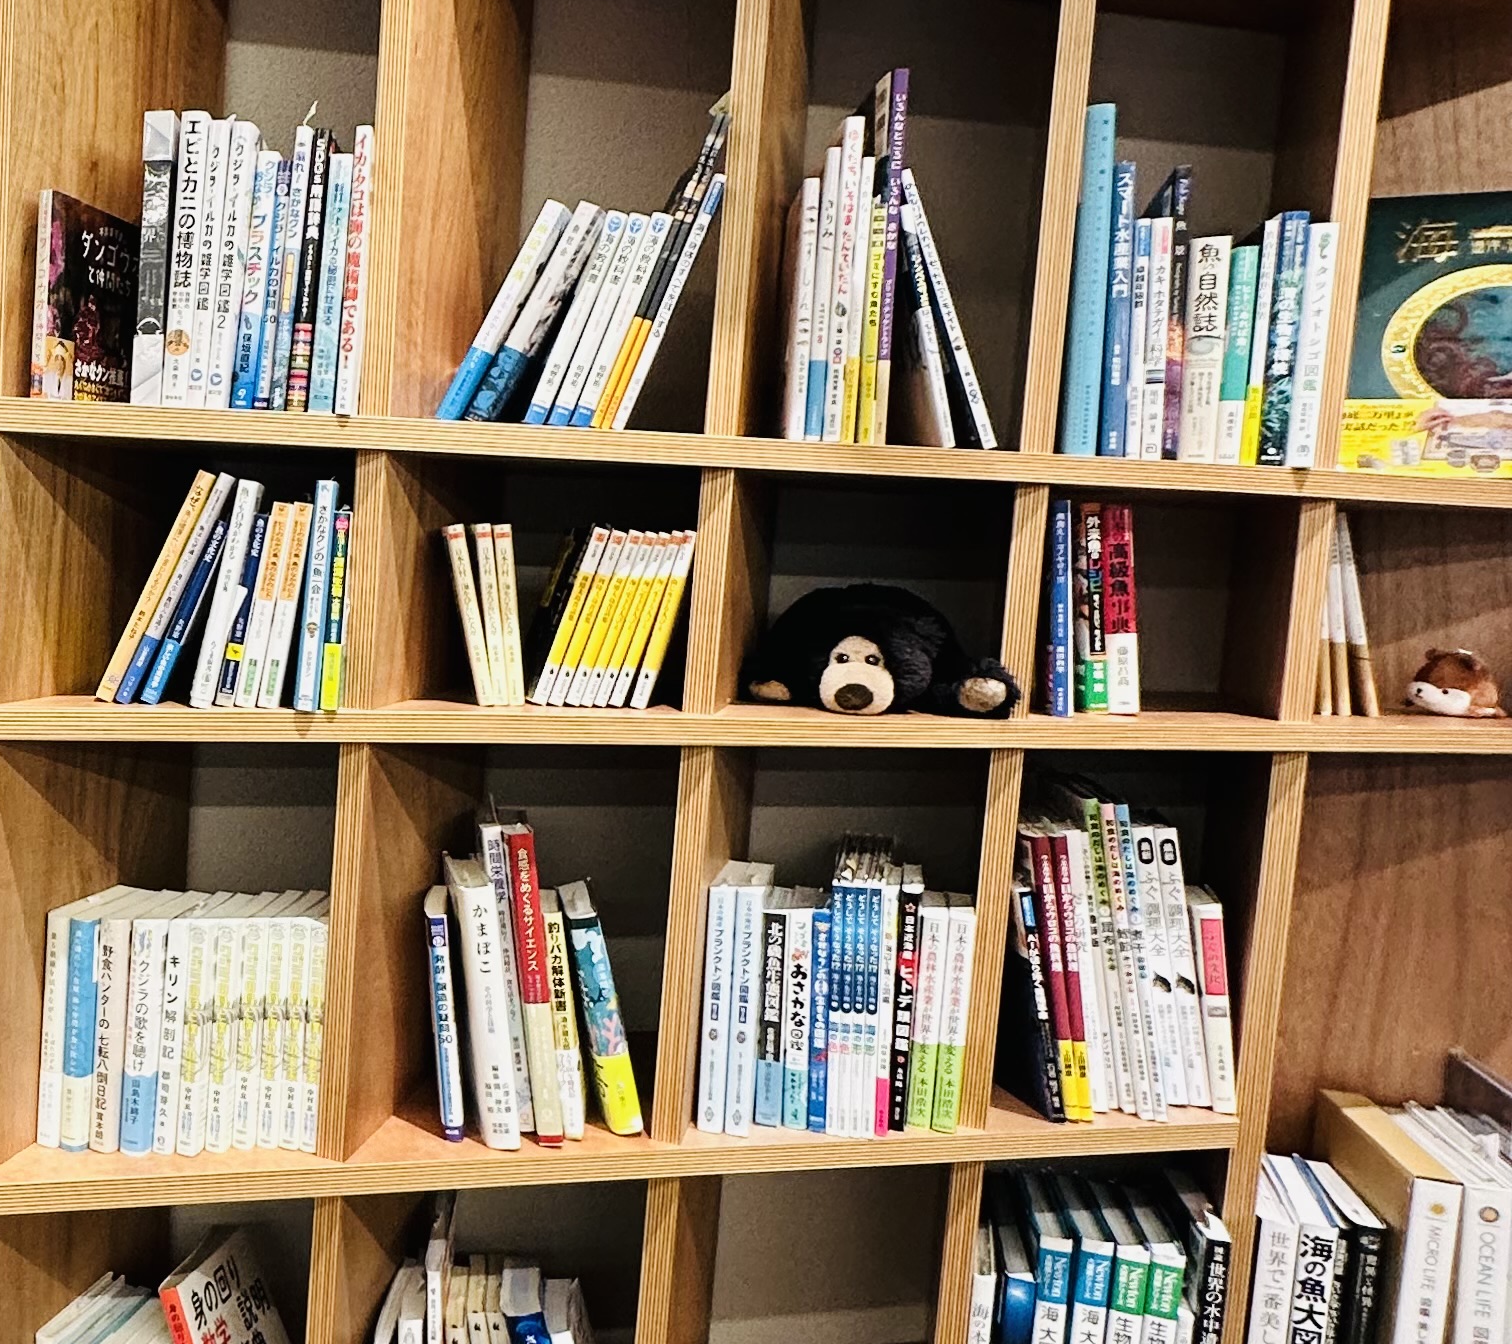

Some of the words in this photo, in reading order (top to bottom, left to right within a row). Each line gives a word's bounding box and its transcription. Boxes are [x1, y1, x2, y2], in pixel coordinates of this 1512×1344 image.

[173, 120, 202, 288] エビとカニの博物誌
[197, 144, 220, 311] クジラ・イルカの雑学図鑑
[1110, 172, 1135, 299] スマート水産業入門
[245, 214, 268, 305] プラスチック
[1193, 243, 1222, 333] 魚の自然誌
[311, 506, 328, 595] さかなクンの一魚一会
[472, 904, 491, 974] かまぼこ
[547, 922, 568, 1012] 釣りバカ解体新書
[94, 944, 114, 1110] 野食ハンターの七転八倒日記
[132, 959, 151, 1073] クジラの歌を聴け
[162, 956, 182, 1060] キリン解剖記
[790, 964, 808, 1051] おさかな図鑑
[1051, 1257, 1068, 1298] Newton
[1092, 1260, 1110, 1300] Newton
[1424, 1223, 1442, 1266] MICRO
[1477, 1230, 1496, 1286] OCEAN
[190, 1257, 240, 1331] 身の回り
[236, 1278, 272, 1328] 説明
[972, 1303, 989, 1344] 海の本
[1128, 1267, 1144, 1310] Newton
[1161, 1272, 1178, 1313] Newton
[1474, 1289, 1492, 1318] LIFE
